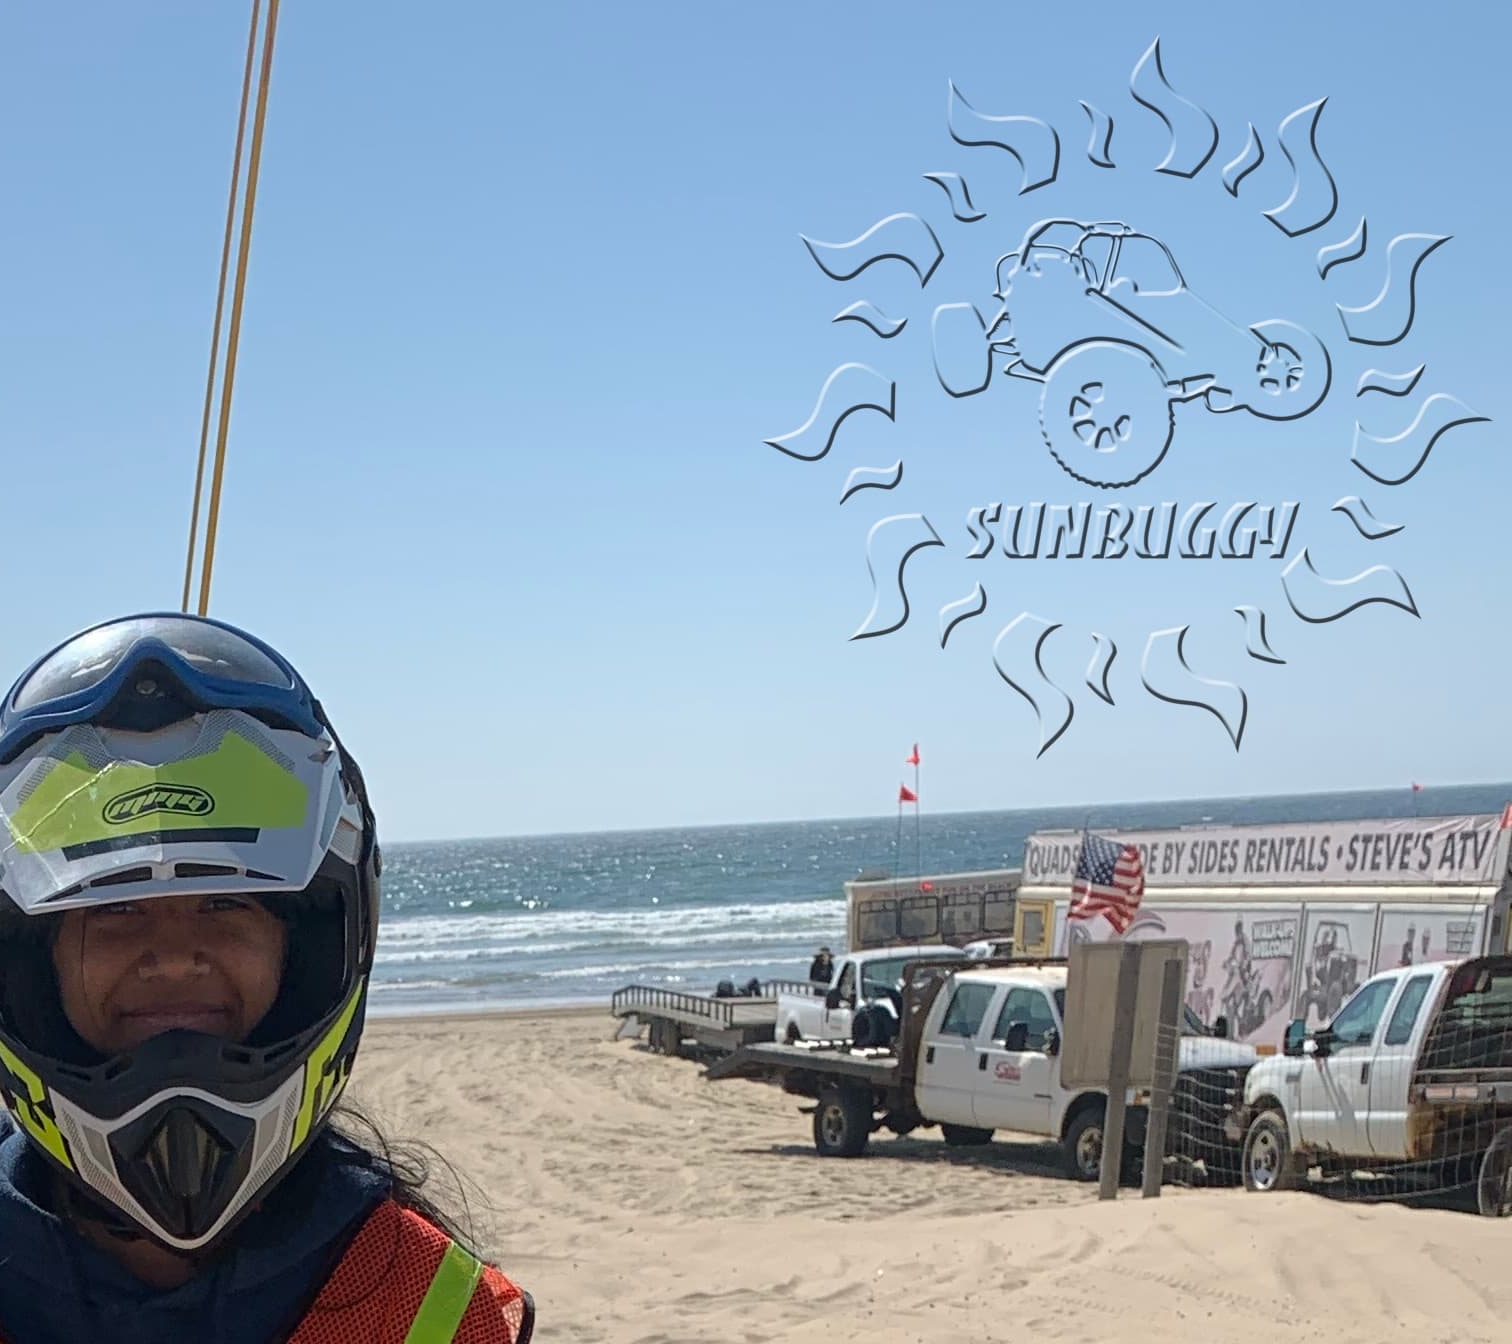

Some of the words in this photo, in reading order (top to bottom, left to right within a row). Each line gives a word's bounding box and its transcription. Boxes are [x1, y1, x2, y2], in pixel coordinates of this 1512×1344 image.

[1162, 841, 1186, 875] BY
[1188, 838, 1238, 875] SIDES
[1244, 835, 1330, 874] RENTALS
[1345, 831, 1434, 872] STEVE'S
[1438, 829, 1491, 871] ATV
